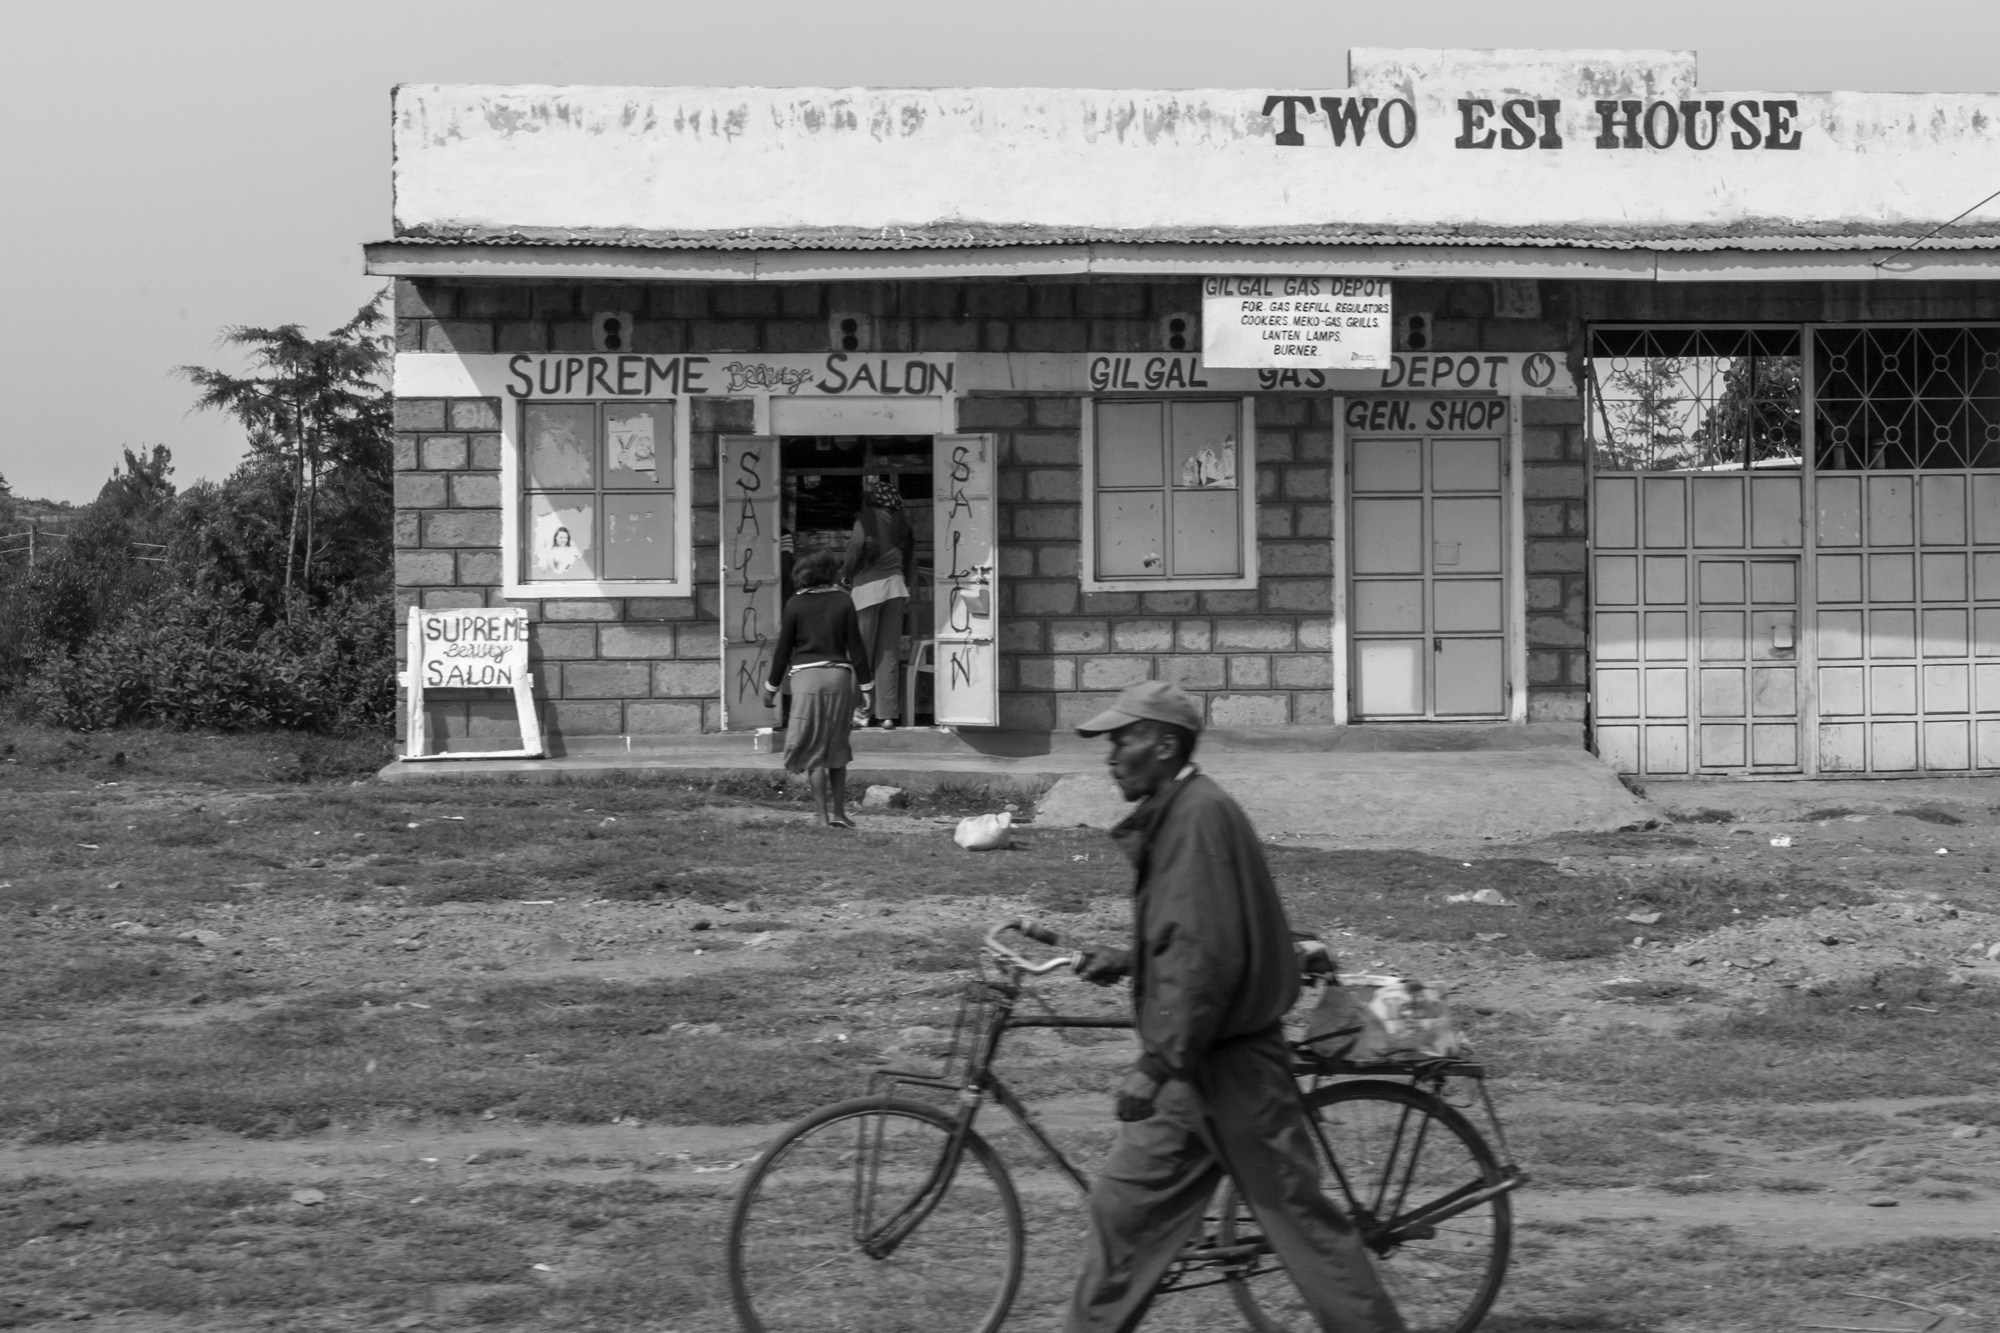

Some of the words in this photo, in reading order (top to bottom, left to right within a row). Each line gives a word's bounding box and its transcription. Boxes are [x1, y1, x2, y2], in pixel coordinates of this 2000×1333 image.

[1262, 95, 1416, 149] TWO
[1455, 99, 1563, 150] ESI
[1595, 99, 1802, 150] HOUSE
[1205, 277, 1273, 297] GILGAL
[1284, 277, 1320, 296] GAS
[1331, 278, 1387, 298] DEPOT
[1269, 302, 1290, 312] GAS
[1262, 330, 1300, 340] LANTEN
[506, 355, 710, 399] SUPREME
[1090, 356, 1208, 392] GILGAL
[1258, 369, 1326, 390] GAS
[1381, 355, 1508, 388] DEPOT
[1345, 400, 1416, 431] GEN.
[1426, 400, 1505, 431] SHOP
[426, 616, 528, 642] SUPREME
[427, 660, 512, 686] SALON
